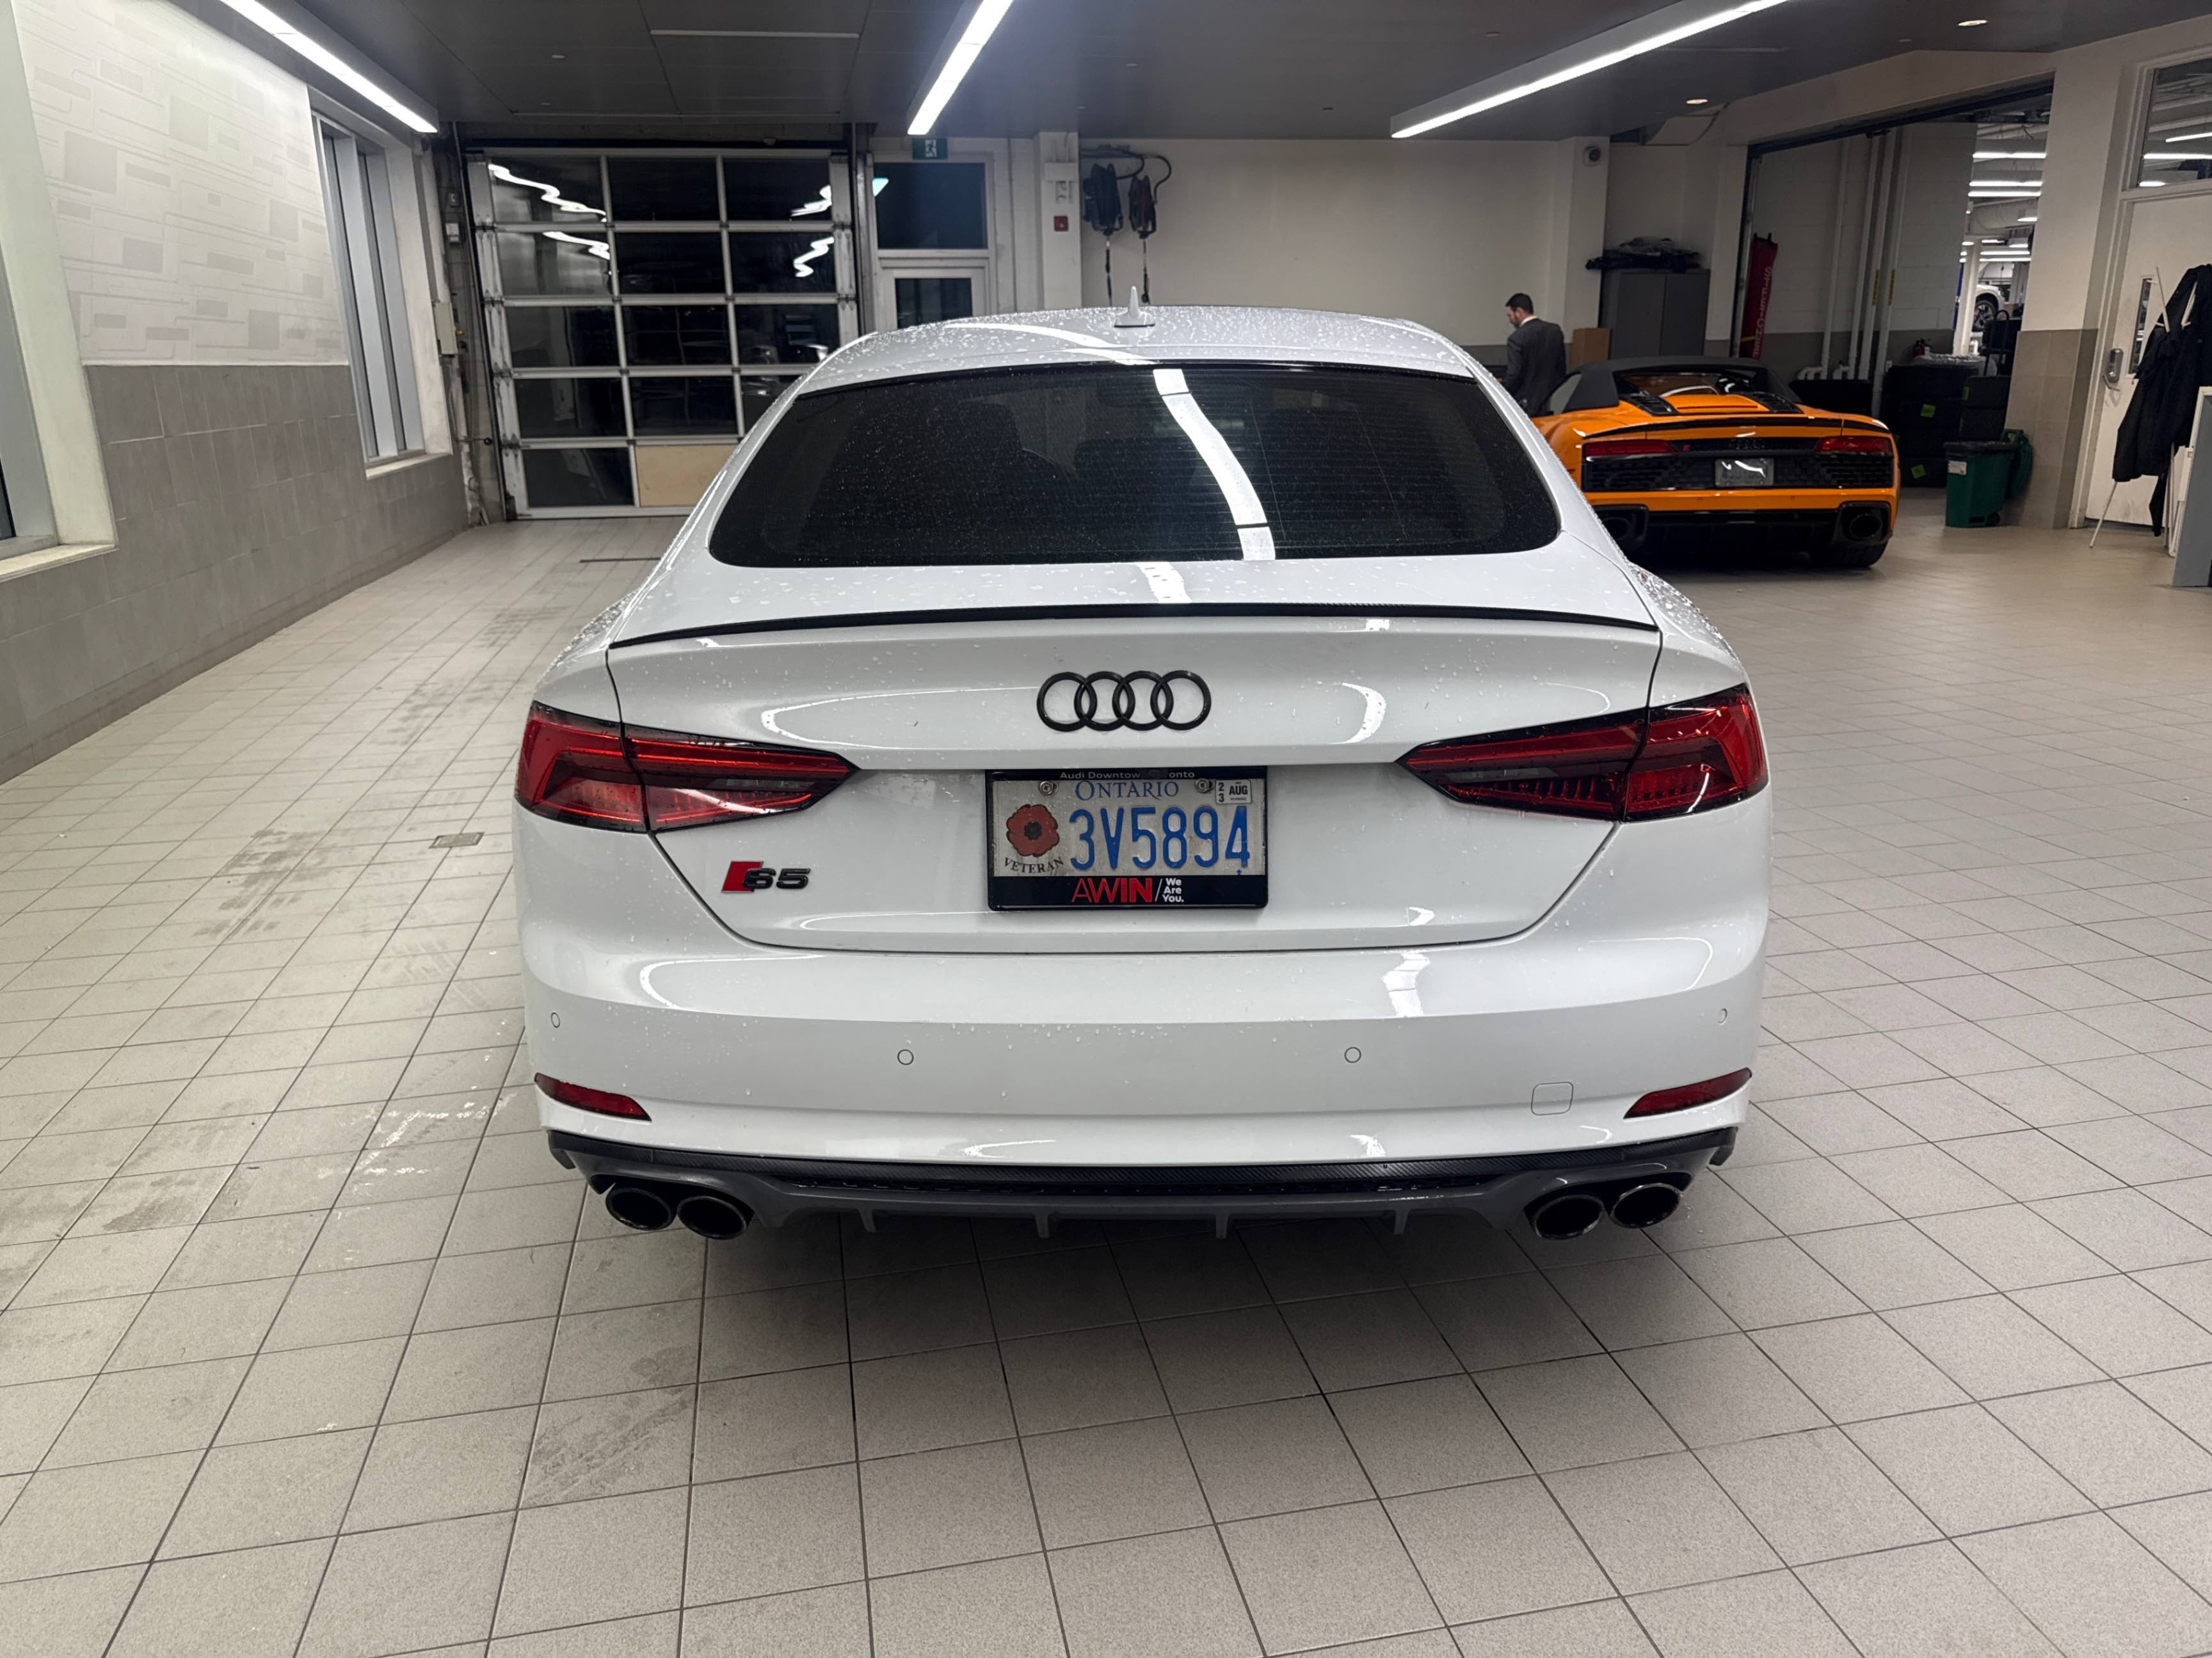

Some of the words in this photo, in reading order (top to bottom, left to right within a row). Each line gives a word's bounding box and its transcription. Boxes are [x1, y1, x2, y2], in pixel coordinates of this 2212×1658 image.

[1060, 771, 1085, 779] Audi
[1088, 771, 1141, 779] Downtow
[1167, 770, 1195, 779] onto
[1075, 780, 1180, 801] ONTARIO
[1229, 785, 1248, 795] AUG
[1069, 806, 1250, 870] 3V5894
[1004, 856, 1064, 873] VETERAN
[742, 868, 811, 889] S5
[1166, 877, 1182, 886] We
[1071, 877, 1153, 903] AWIN
[1162, 894, 1184, 903] You.
